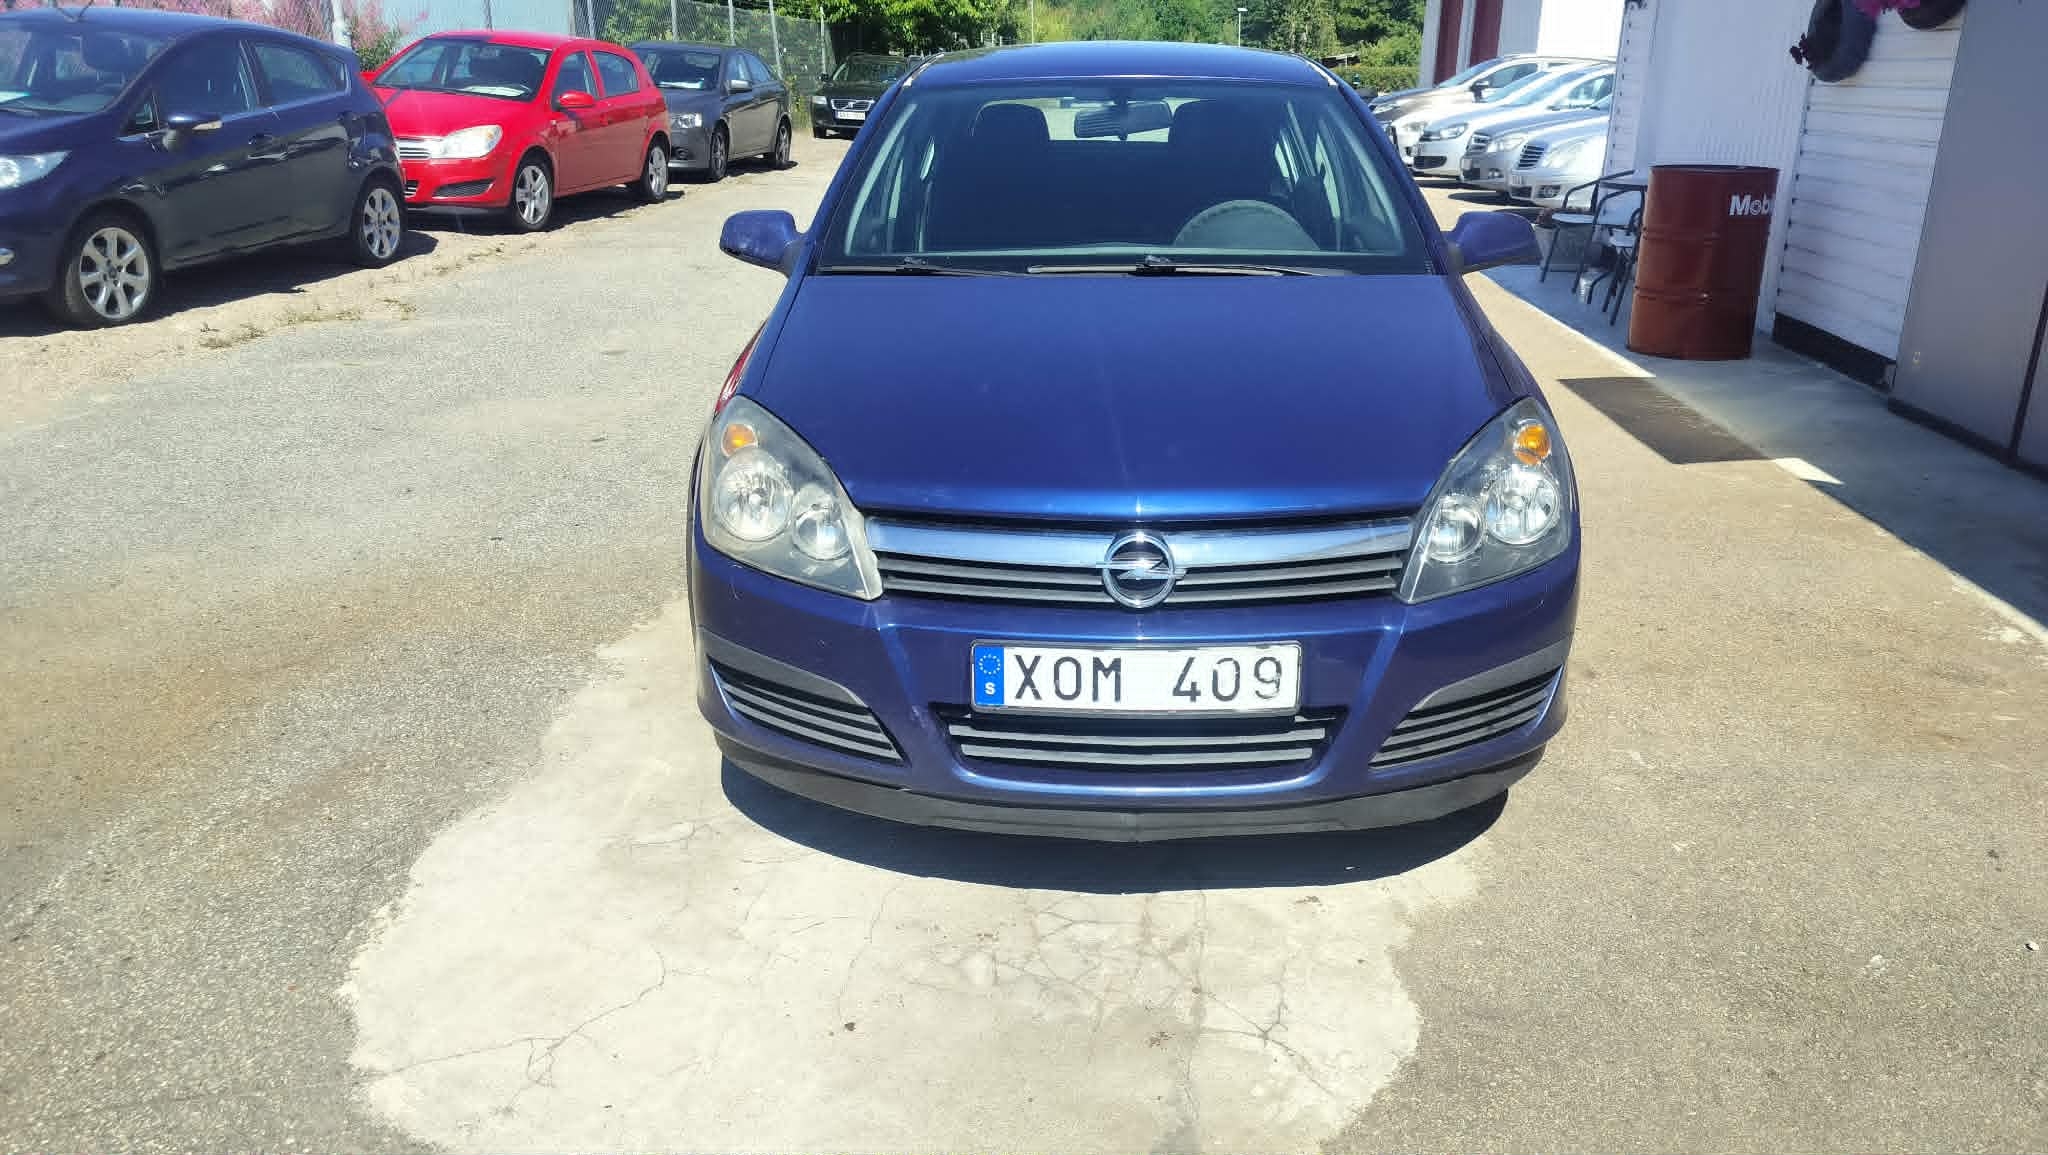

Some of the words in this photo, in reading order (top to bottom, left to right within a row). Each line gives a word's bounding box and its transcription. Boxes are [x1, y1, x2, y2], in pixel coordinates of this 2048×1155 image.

[984, 681, 997, 696] S
[1014, 654, 1122, 702] XOM
[1172, 656, 1282, 702] 409
